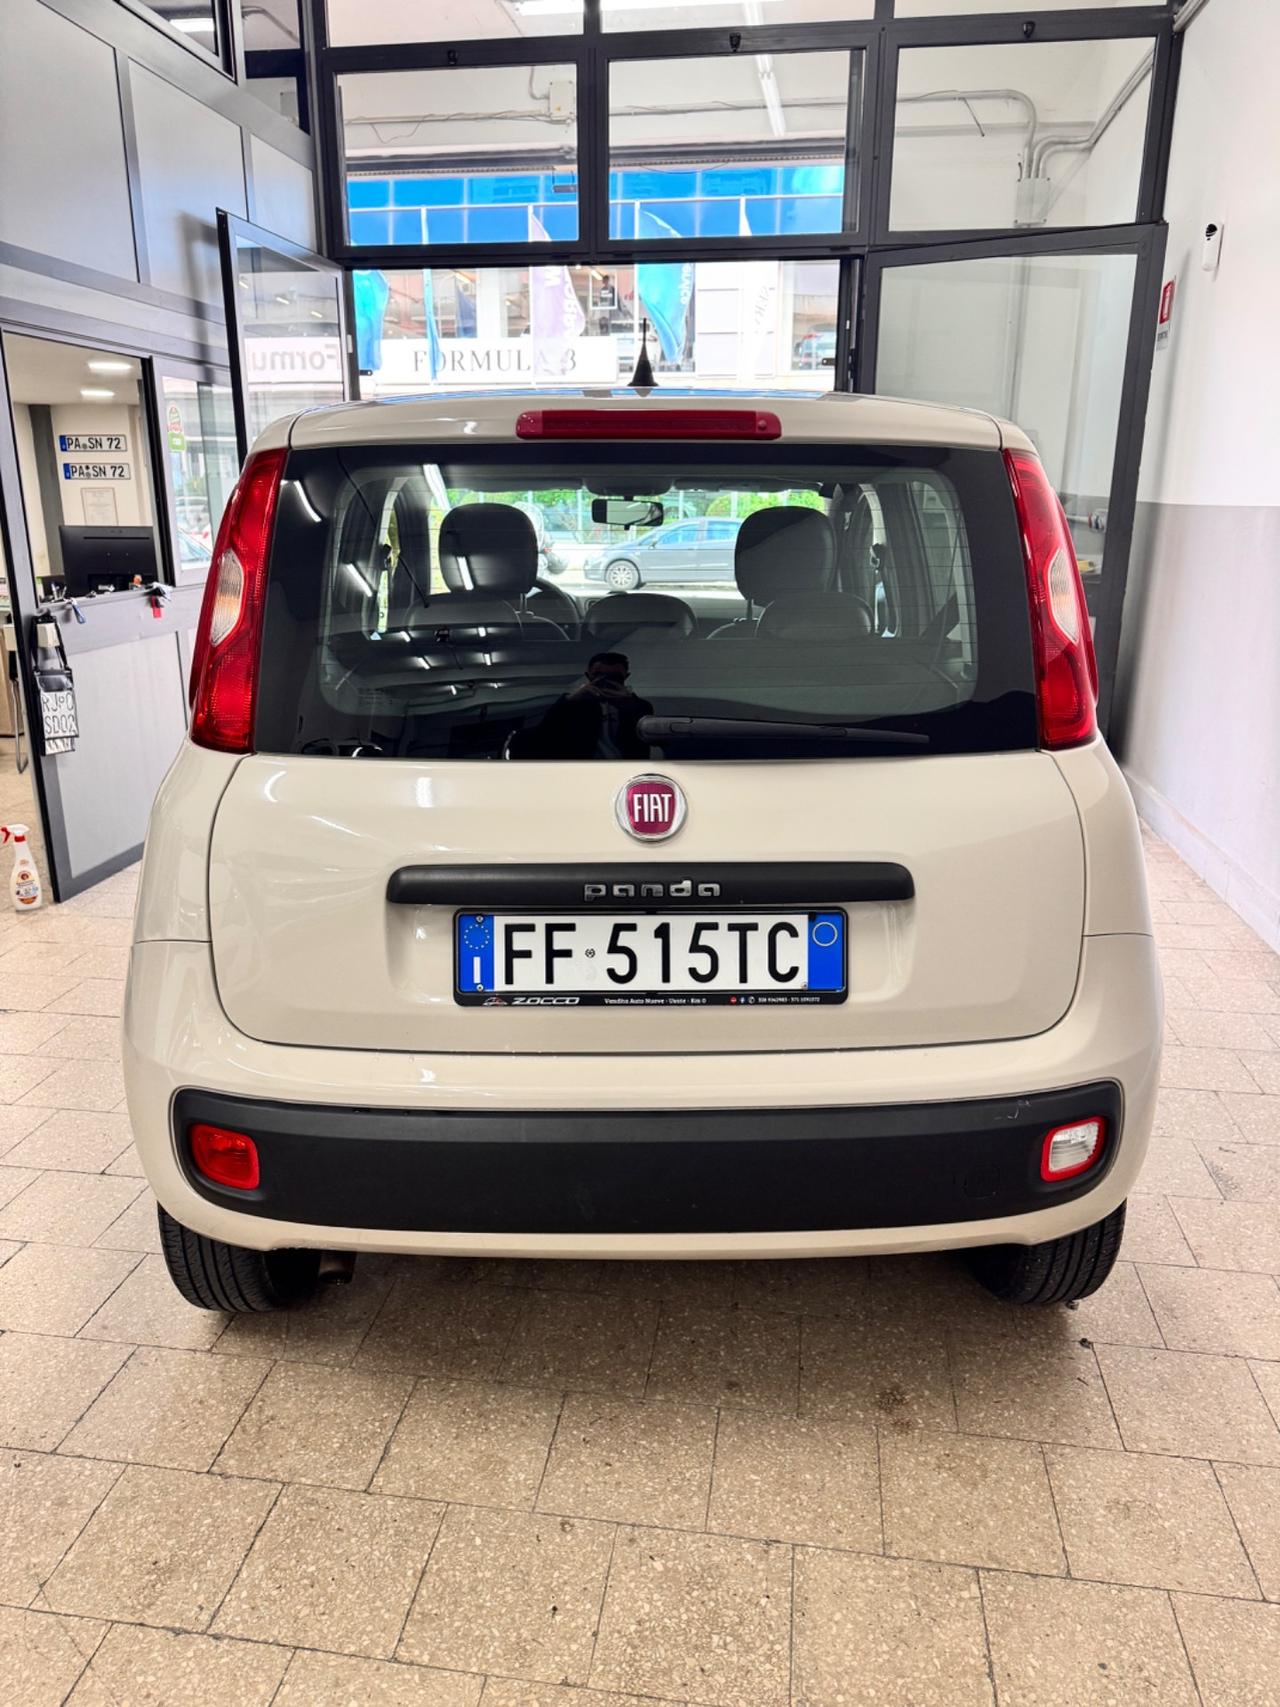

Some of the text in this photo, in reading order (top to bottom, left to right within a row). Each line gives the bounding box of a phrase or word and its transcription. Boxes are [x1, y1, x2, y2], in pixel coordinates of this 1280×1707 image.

[413, 350, 532, 372] FORMUL
[67, 437, 121, 450] PA SN 72
[70, 465, 125, 478] PA SN 72
[633, 793, 672, 822] FIAT
[584, 880, 720, 901] panda
[504, 923, 577, 985] FF
[606, 922, 799, 985] 515TC
[511, 997, 580, 1005] ZOCCO
